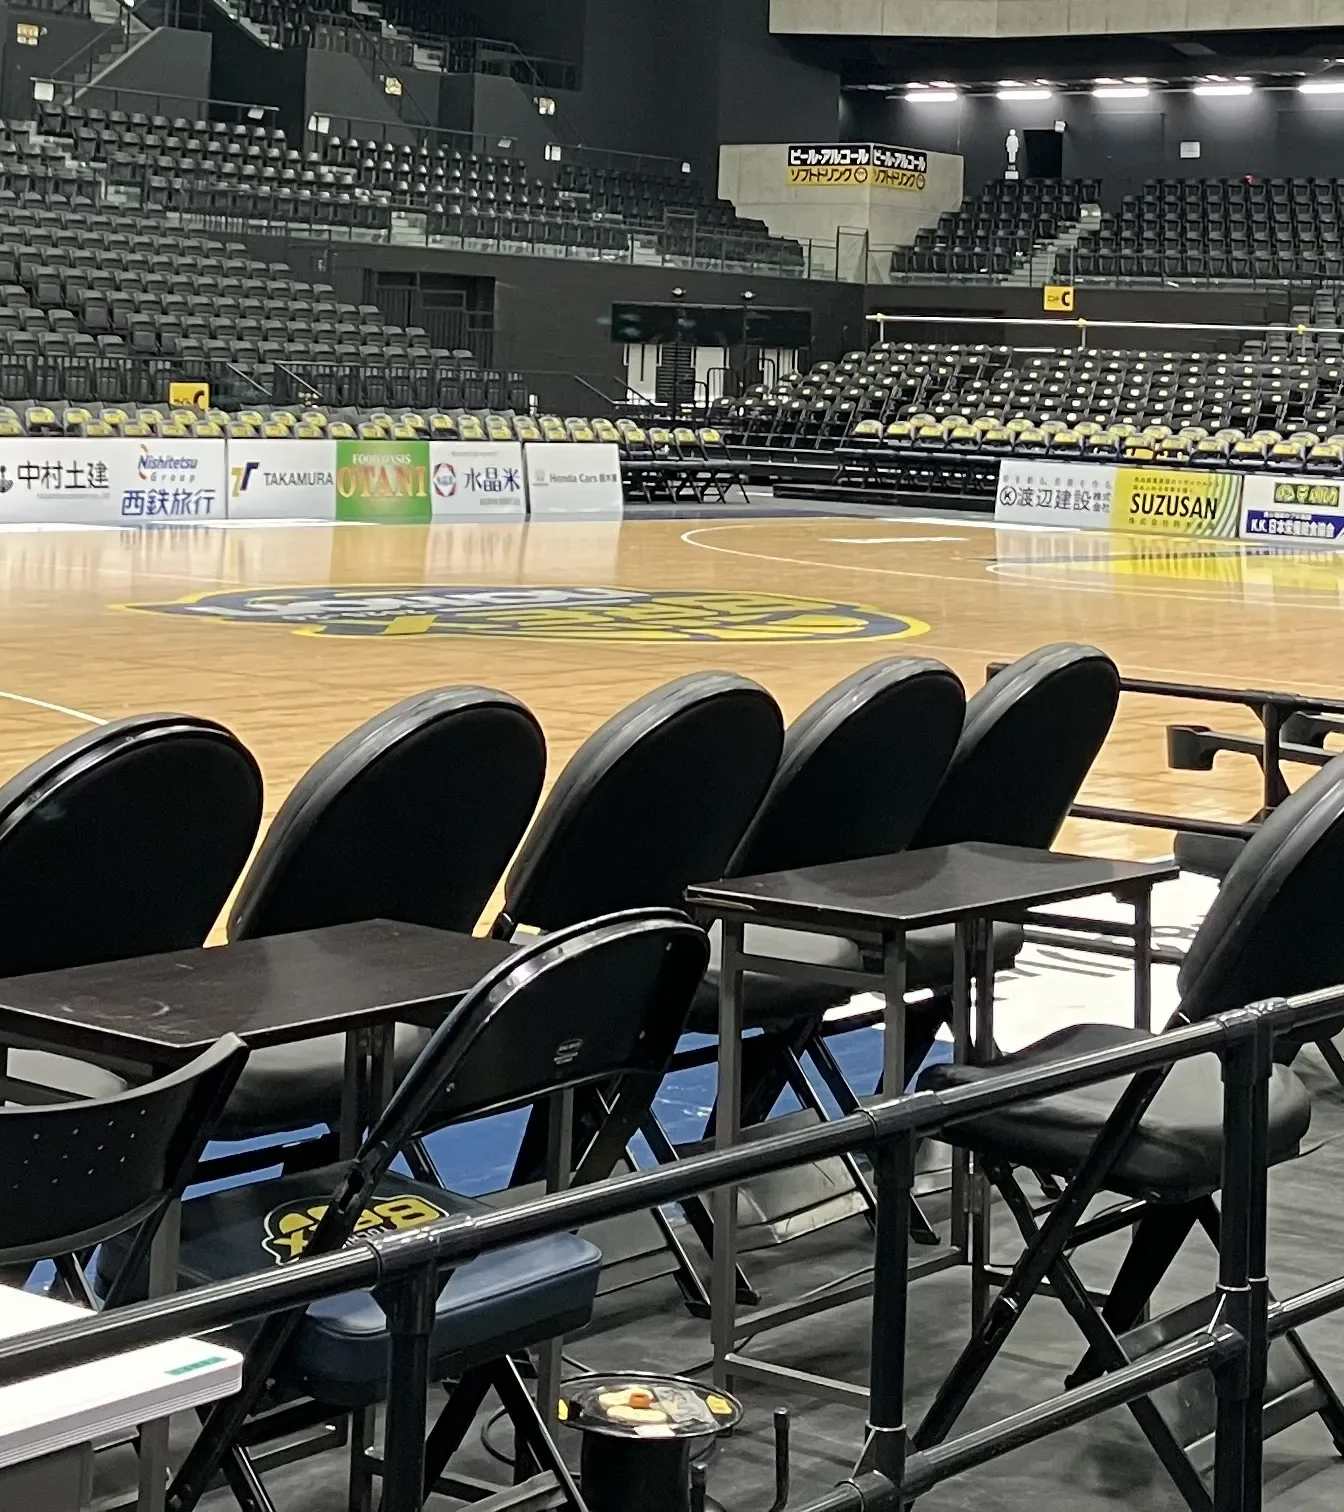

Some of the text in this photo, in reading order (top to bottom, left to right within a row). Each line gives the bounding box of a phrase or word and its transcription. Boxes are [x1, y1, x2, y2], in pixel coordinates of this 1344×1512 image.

[791, 168, 852, 182] ソフトドリンク
[17, 460, 109, 490] 中村土建
[138, 454, 198, 471] Nishitetsu
[150, 472, 195, 483] Group
[263, 472, 334, 487] TAKAMURA
[337, 466, 427, 498] OTANI
[464, 467, 520, 493] 水晶米
[549, 473, 577, 483] Honda
[122, 489, 215, 516] 西鉄旅行
[1130, 493, 1217, 519] SUZUSAN
[272, 1199, 440, 1257] BRX
